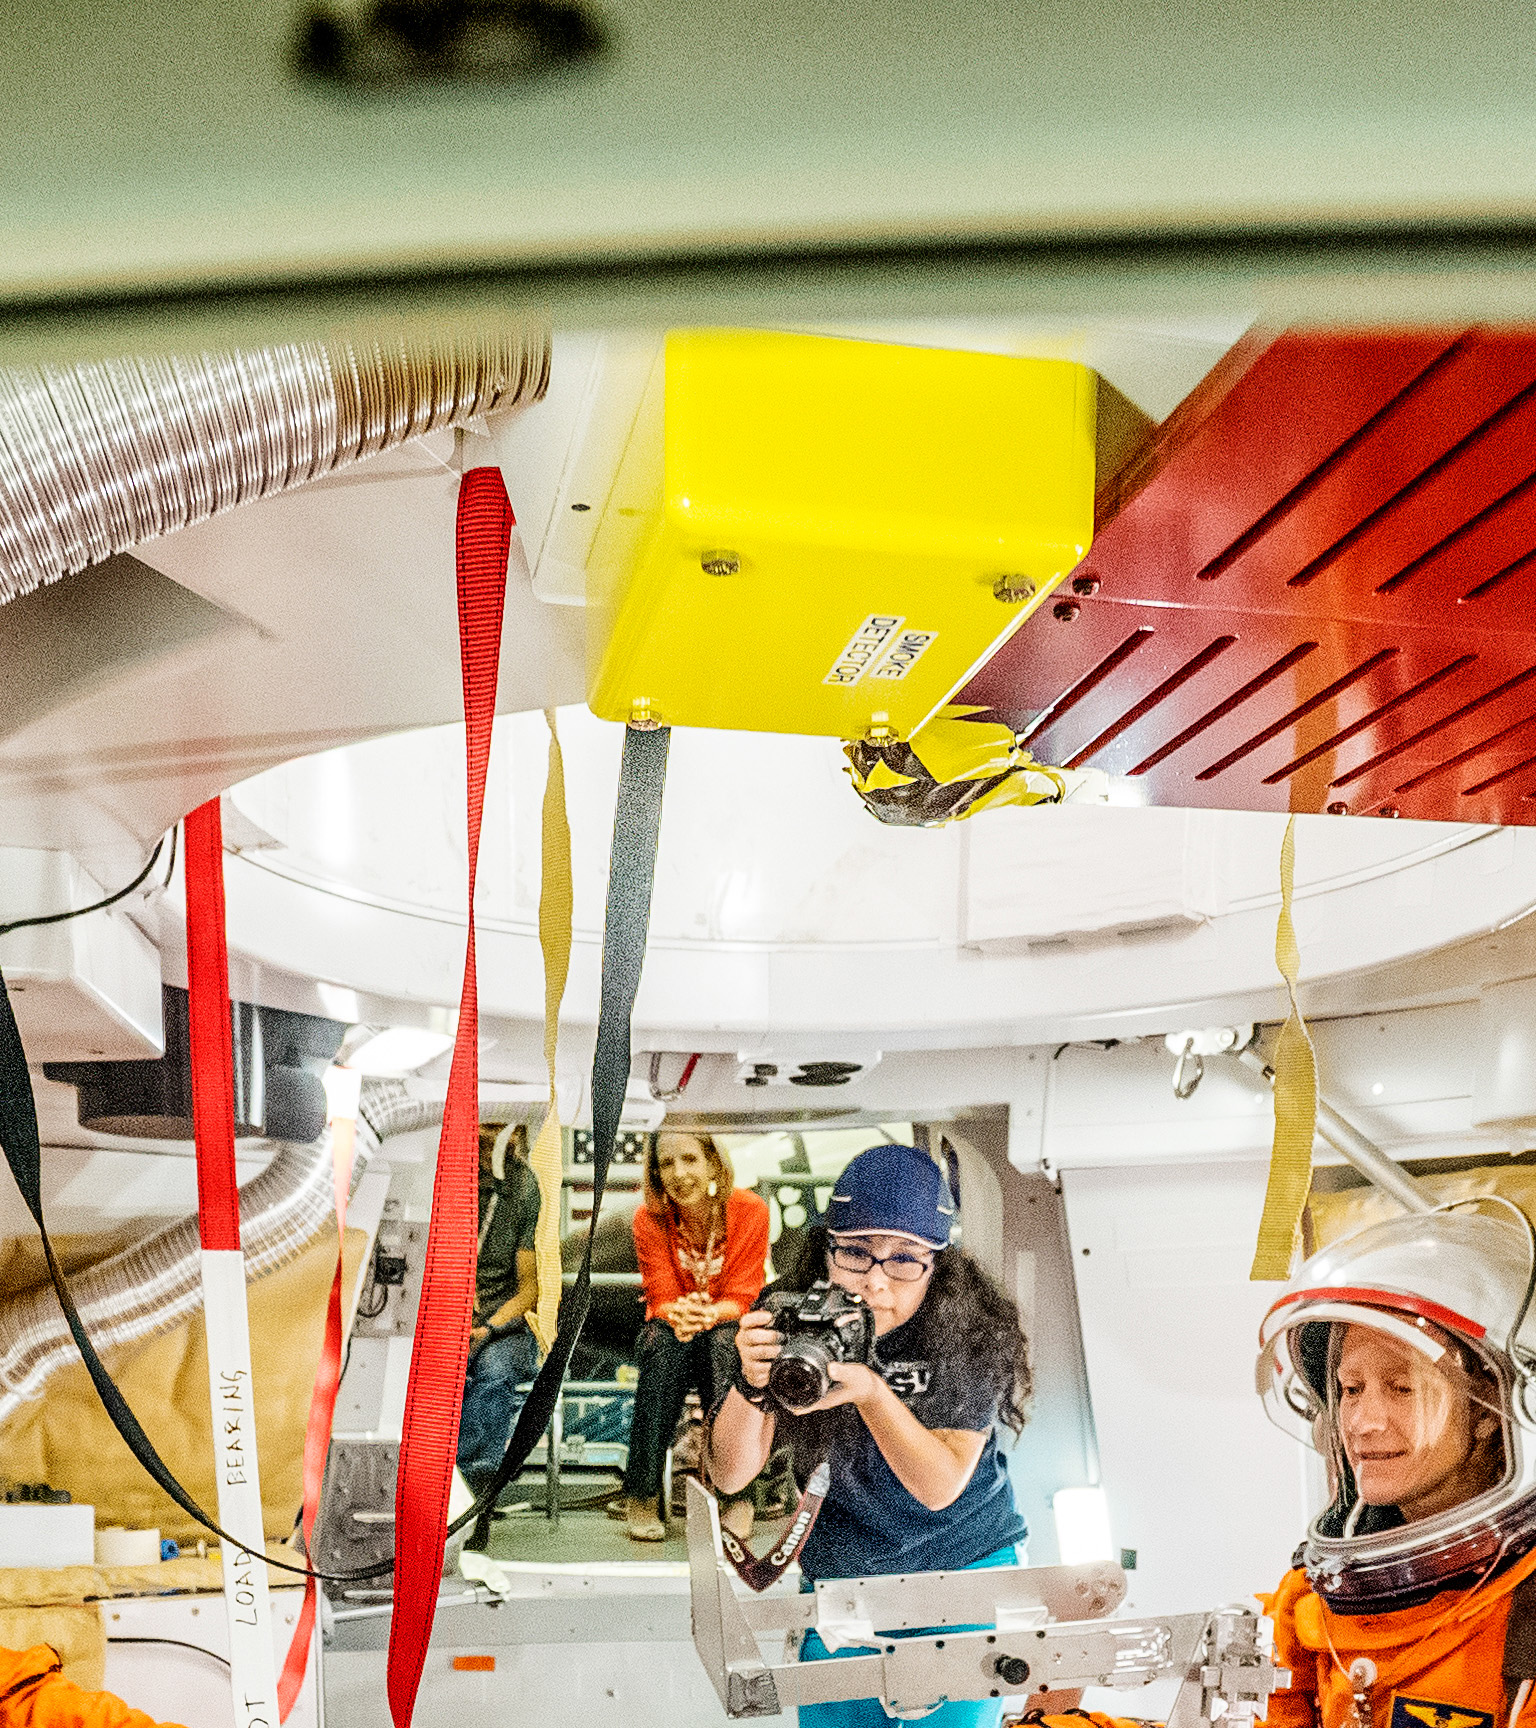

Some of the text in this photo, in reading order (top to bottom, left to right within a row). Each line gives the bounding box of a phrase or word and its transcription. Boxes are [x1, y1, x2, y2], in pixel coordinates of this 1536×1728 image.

[829, 615, 900, 684] DETECTOR
[875, 631, 932, 678] SMOKE
[220, 1369, 247, 1487] BEARING
[770, 1510, 812, 1567] Canon
[233, 1546, 258, 1627] LOAD
